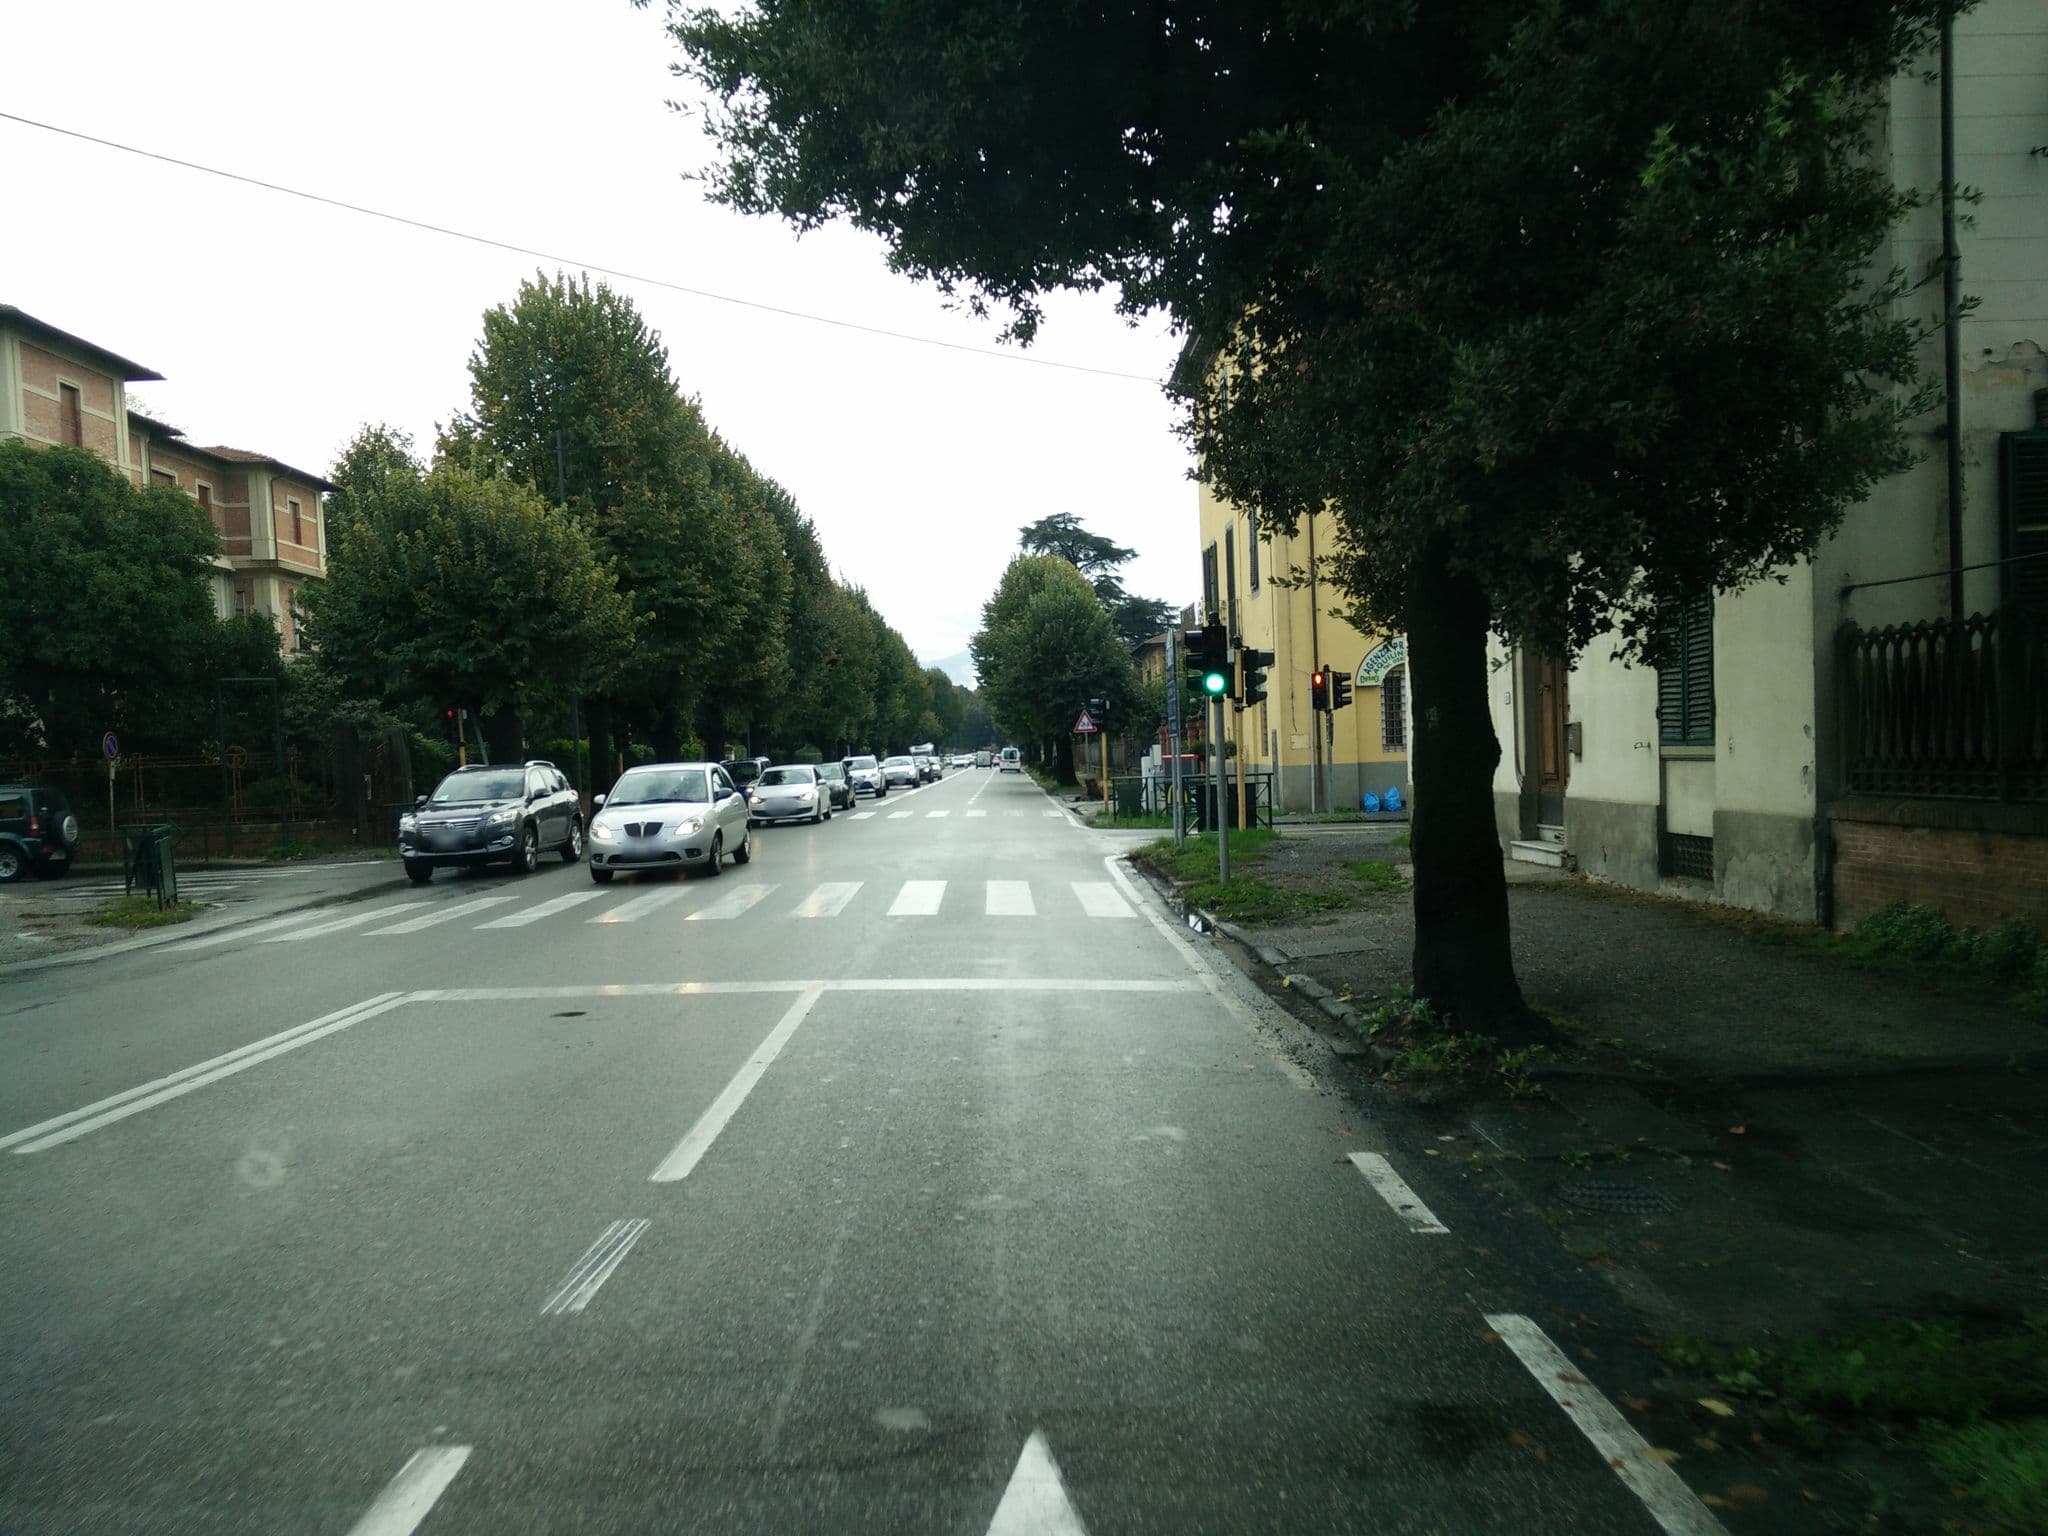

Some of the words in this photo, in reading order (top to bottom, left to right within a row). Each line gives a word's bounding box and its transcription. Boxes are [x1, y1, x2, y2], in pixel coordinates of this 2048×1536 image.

[1364, 644, 1392, 675] AGENZIA
[1392, 640, 1404, 651] PR
[1374, 650, 1404, 674] AQUILIN
